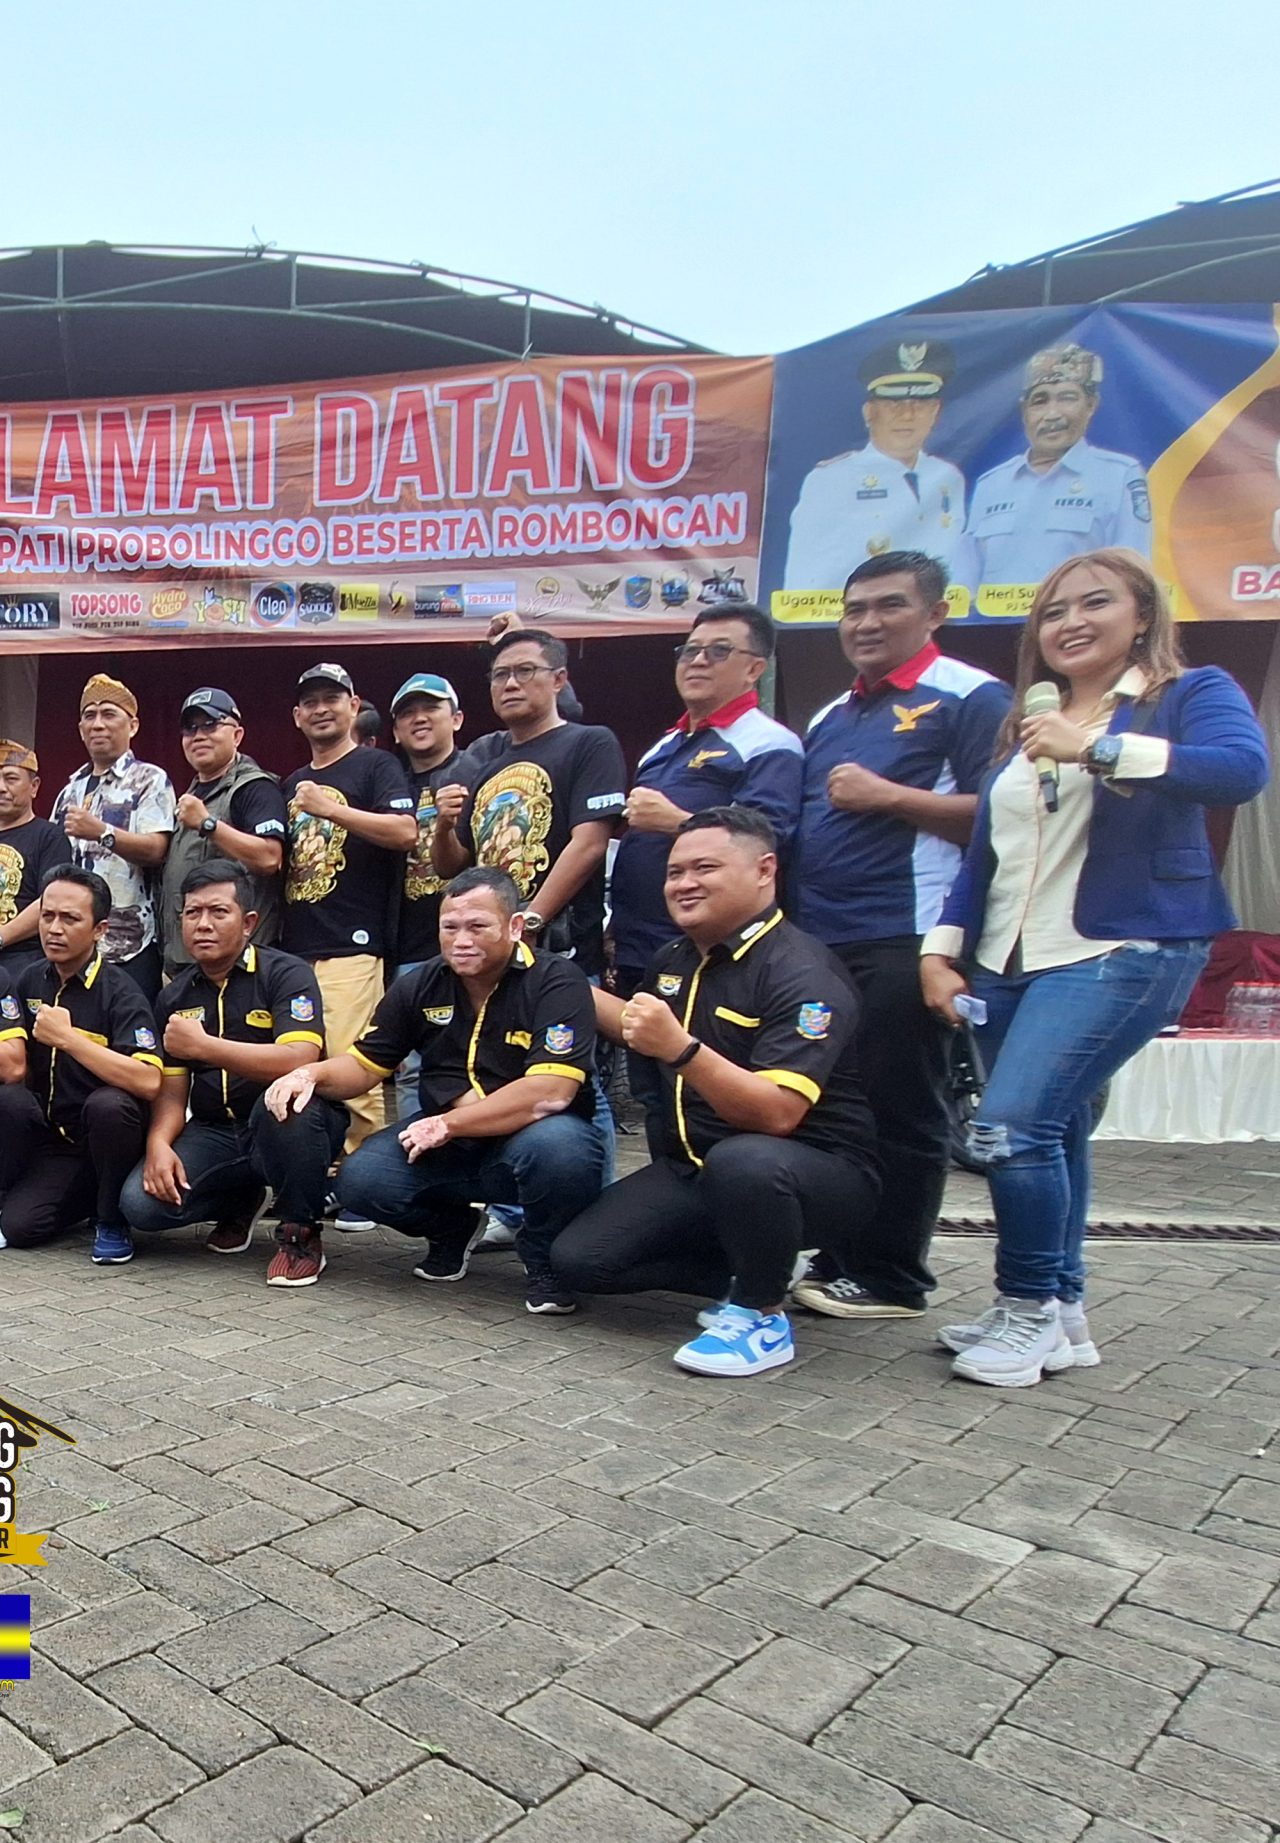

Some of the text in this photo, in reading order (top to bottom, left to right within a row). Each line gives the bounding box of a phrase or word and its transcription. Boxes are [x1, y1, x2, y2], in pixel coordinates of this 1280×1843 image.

[314, 364, 696, 508] DATANG
[74, 520, 322, 570] PROBOLINGGO
[330, 510, 487, 560] BESERTA
[496, 497, 745, 550] ROMBONGAN
[152, 591, 186, 605] Hydro
[781, 595, 814, 607] Ugas
[986, 588, 1013, 599] Heri
[70, 592, 143, 617] TOPSONG
[152, 602, 182, 618] Coco
[260, 597, 287, 615] Cleo
[415, 601, 439, 612] burung
